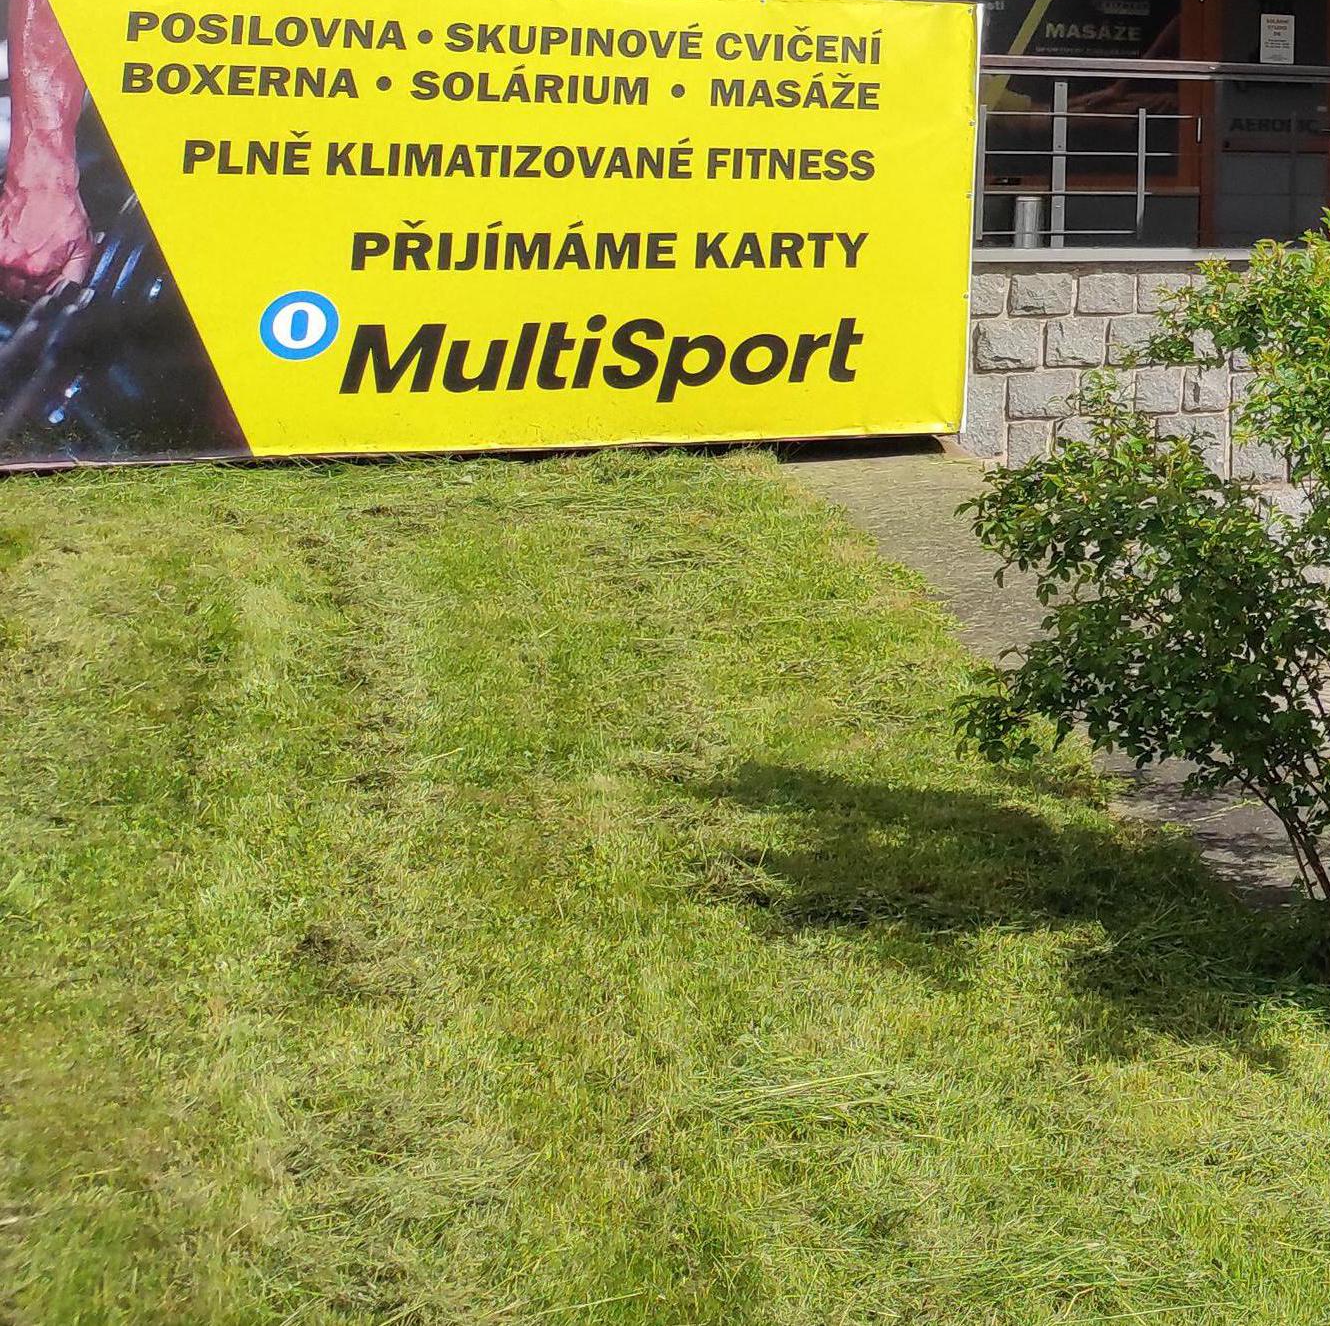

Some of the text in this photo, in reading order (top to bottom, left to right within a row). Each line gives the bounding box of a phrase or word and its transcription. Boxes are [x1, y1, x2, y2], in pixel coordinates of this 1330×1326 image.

[126, 11, 883, 65] POSILOVNA SKUPINOVÉ CVIČENÍ
[121, 62, 881, 111] BOXERNA SOLÁRIUM MASÁŽE
[183, 130, 876, 182] PLNĚ KLIMATIZOVANÉ FITNESS
[350, 220, 870, 272] PŘIJÍMÁME KARTY
[339, 313, 863, 404] MultiSport
